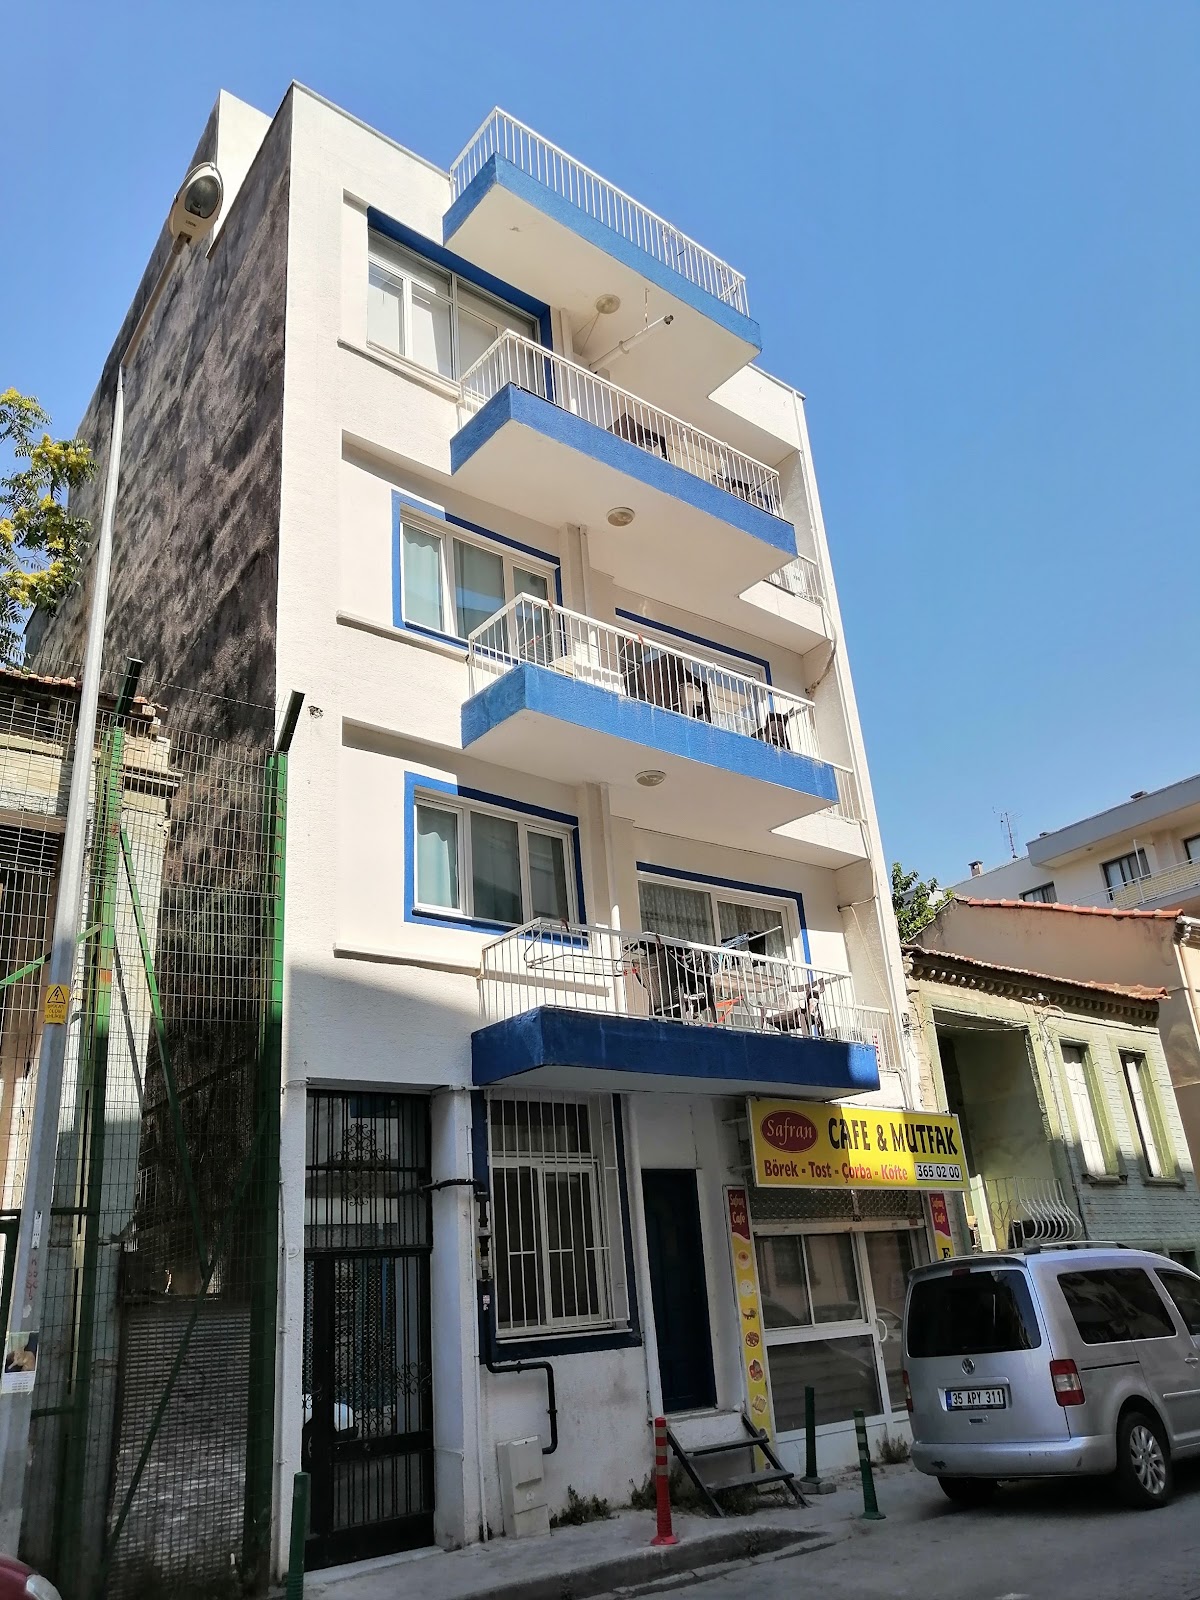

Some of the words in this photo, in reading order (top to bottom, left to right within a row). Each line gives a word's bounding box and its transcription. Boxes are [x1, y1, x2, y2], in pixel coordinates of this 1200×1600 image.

[766, 1117, 813, 1146] Safran
[828, 1117, 871, 1151] CAFE
[876, 1124, 889, 1152] &
[889, 1122, 959, 1156] MUTFAK
[764, 1158, 799, 1178] Börek
[808, 1161, 832, 1179] Tost
[841, 1163, 873, 1184] Çorba
[881, 1163, 908, 1181] Köfte
[917, 1164, 934, 1178] 365
[936, 1165, 947, 1179] 02
[949, 1166, 960, 1179] 00
[732, 1211, 746, 1225] Cafe
[952, 1392, 963, 1405] 35
[967, 1391, 982, 1404] APY
[985, 1390, 1003, 1404] 311
